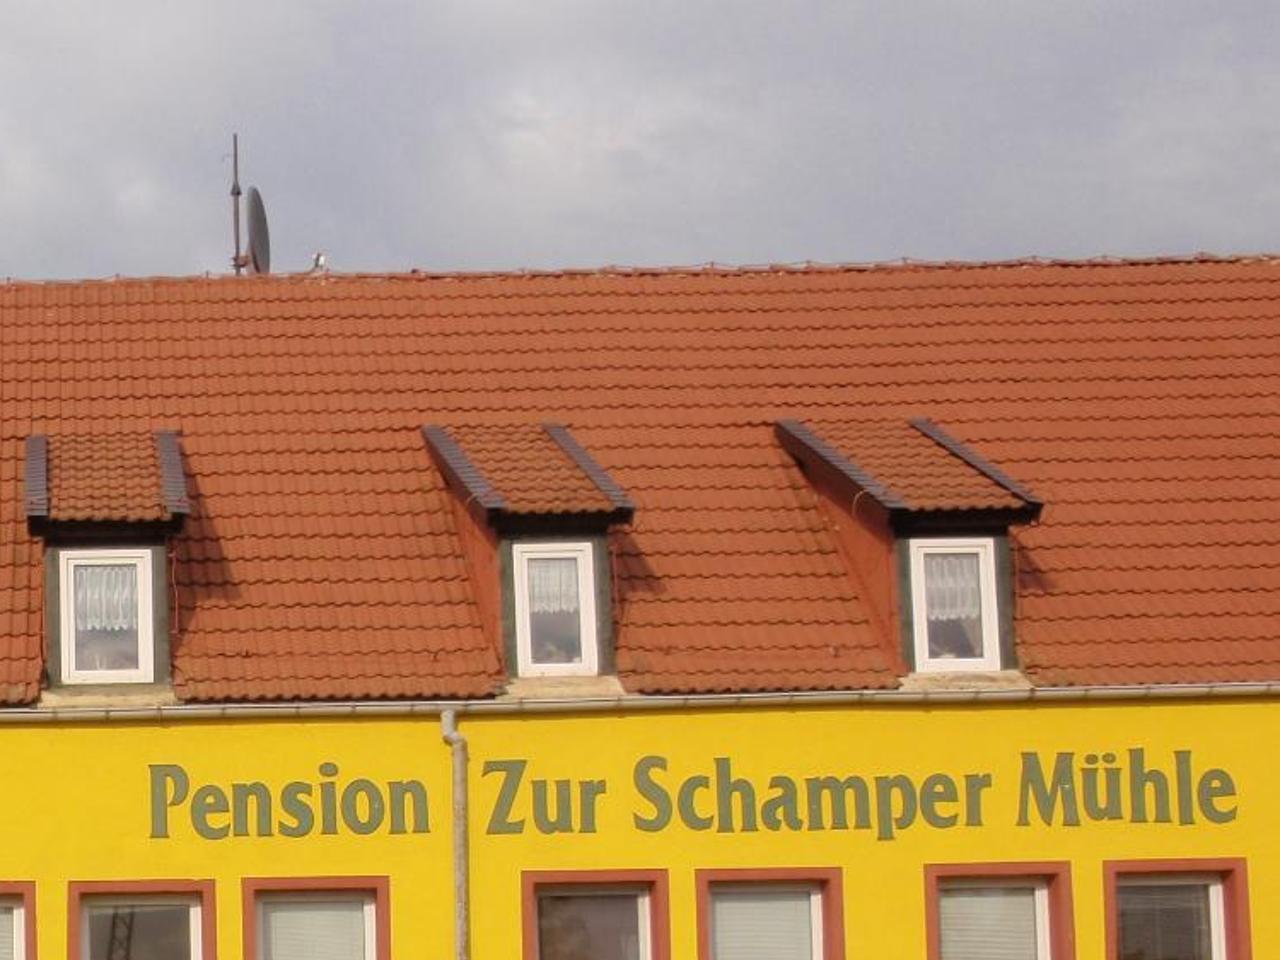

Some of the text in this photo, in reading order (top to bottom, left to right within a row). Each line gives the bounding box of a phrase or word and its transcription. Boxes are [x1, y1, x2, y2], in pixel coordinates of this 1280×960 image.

[148, 748, 1238, 841] Pension Zur Schamper Mühle
